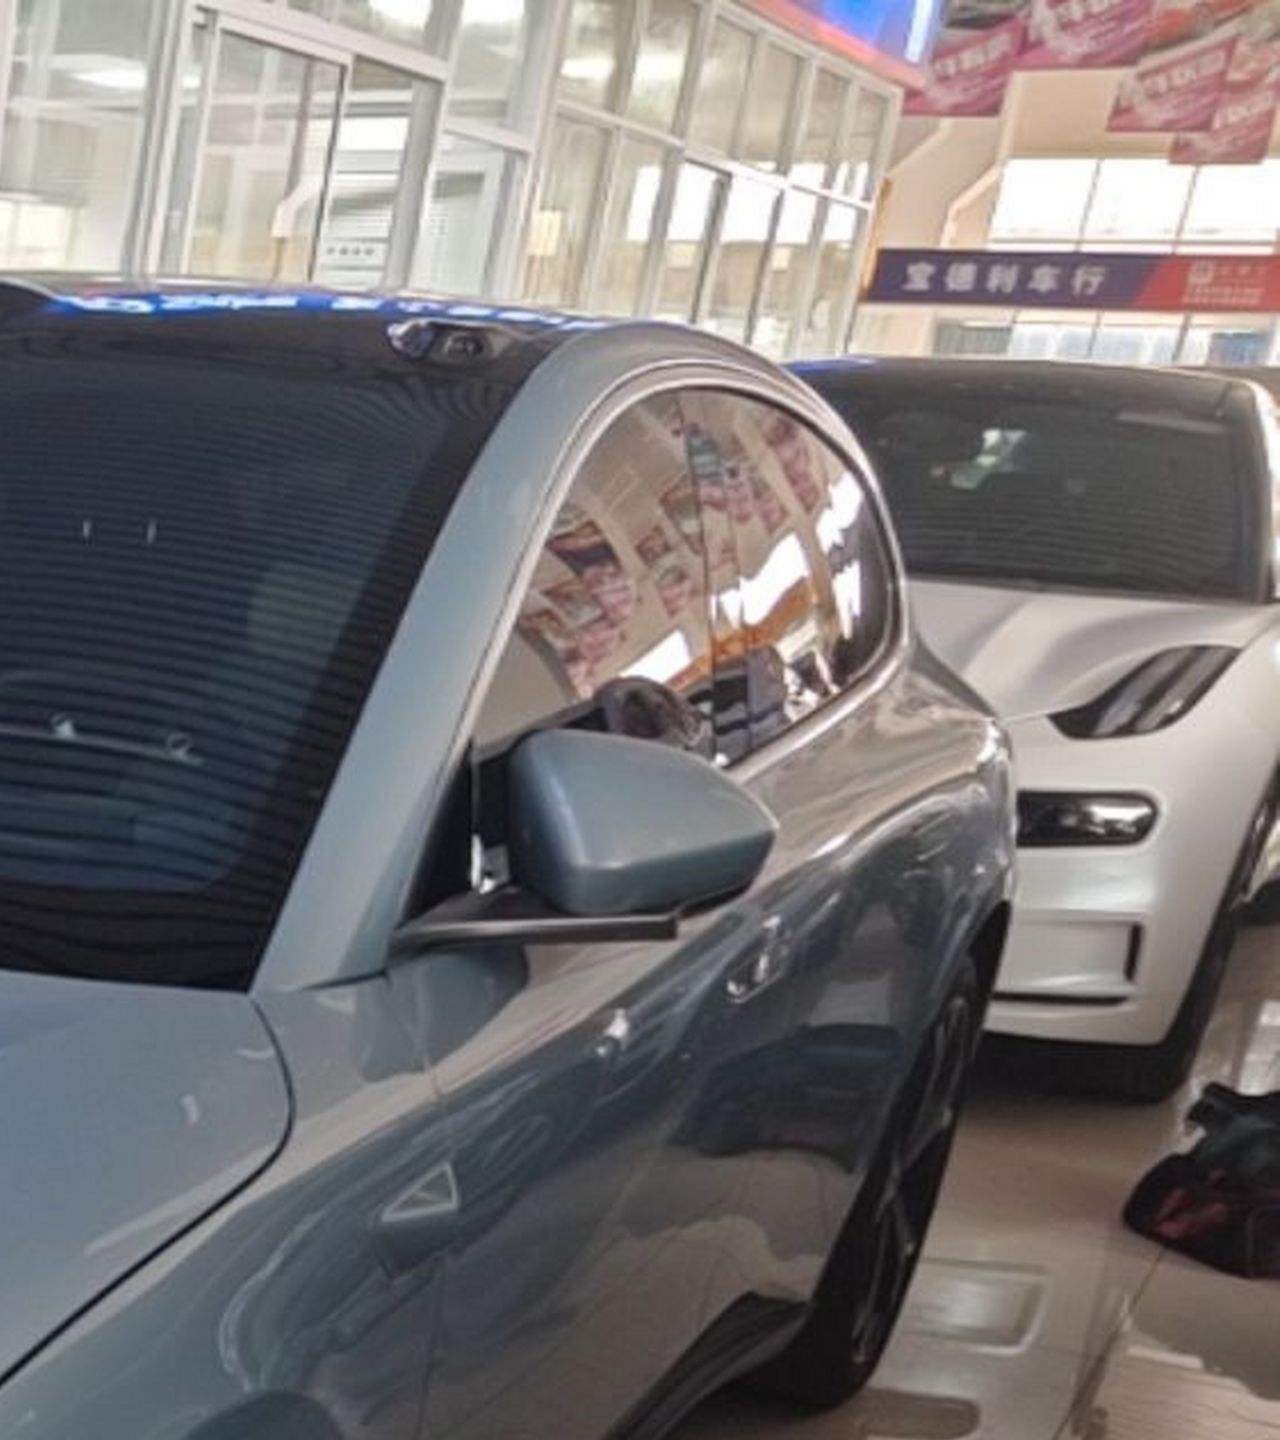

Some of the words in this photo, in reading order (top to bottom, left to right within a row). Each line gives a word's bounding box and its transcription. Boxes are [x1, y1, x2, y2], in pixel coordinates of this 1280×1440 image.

[904, 262, 1106, 296] 宝德利车行
